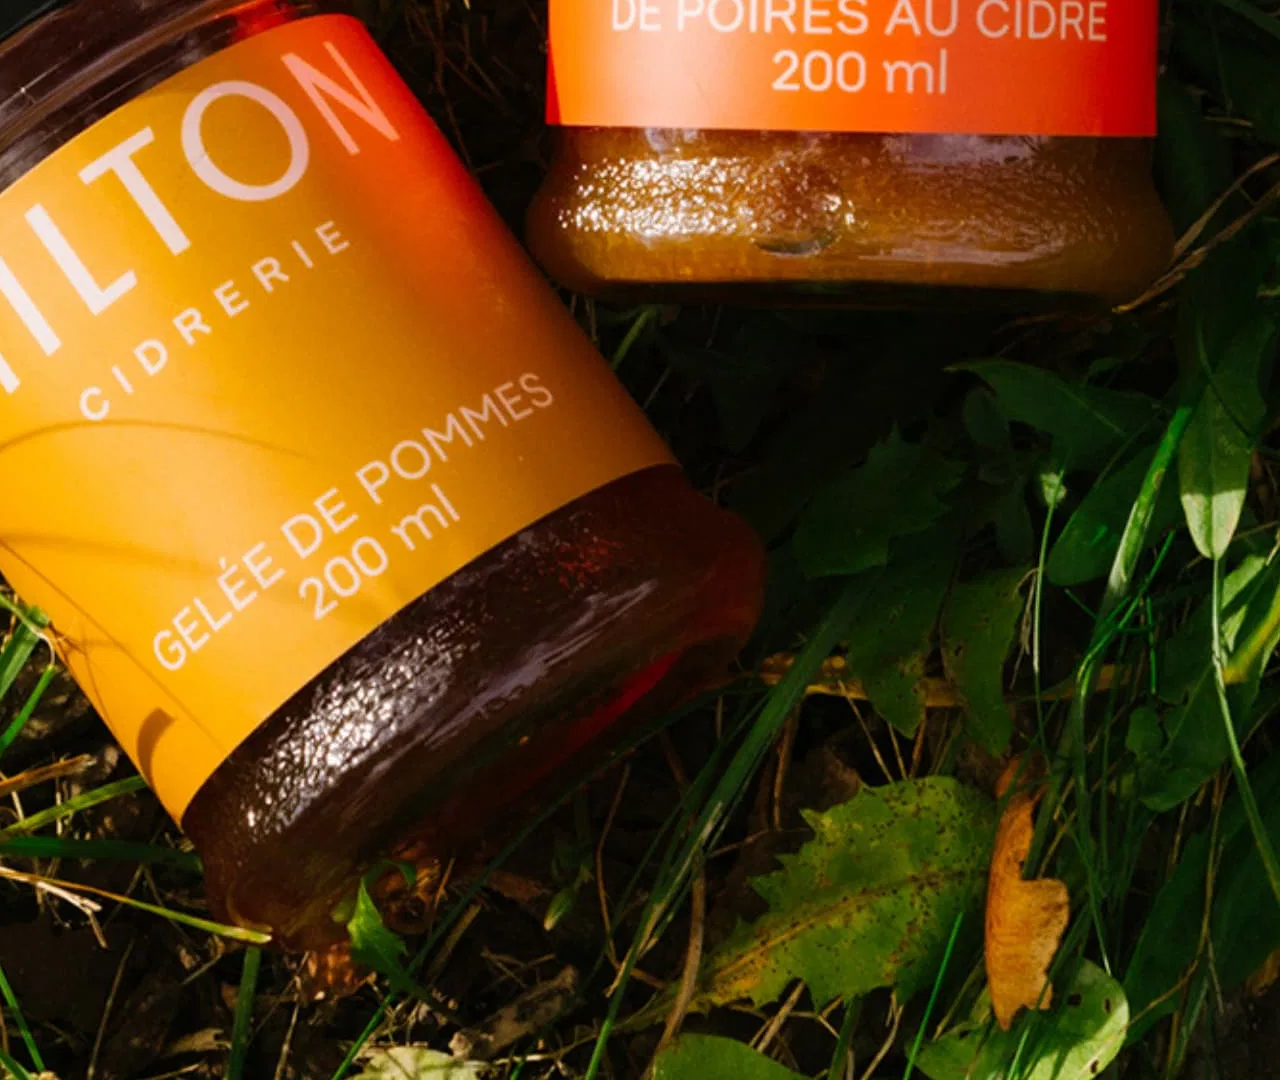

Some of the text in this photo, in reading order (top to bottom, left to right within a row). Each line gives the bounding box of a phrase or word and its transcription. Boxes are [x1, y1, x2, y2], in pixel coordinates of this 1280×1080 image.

[771, 48, 949, 94] 200 ml
[78, 219, 351, 422] CIDRERIE
[152, 372, 554, 671] GELÉE DE POMMES
[297, 483, 461, 620] 200 ml
